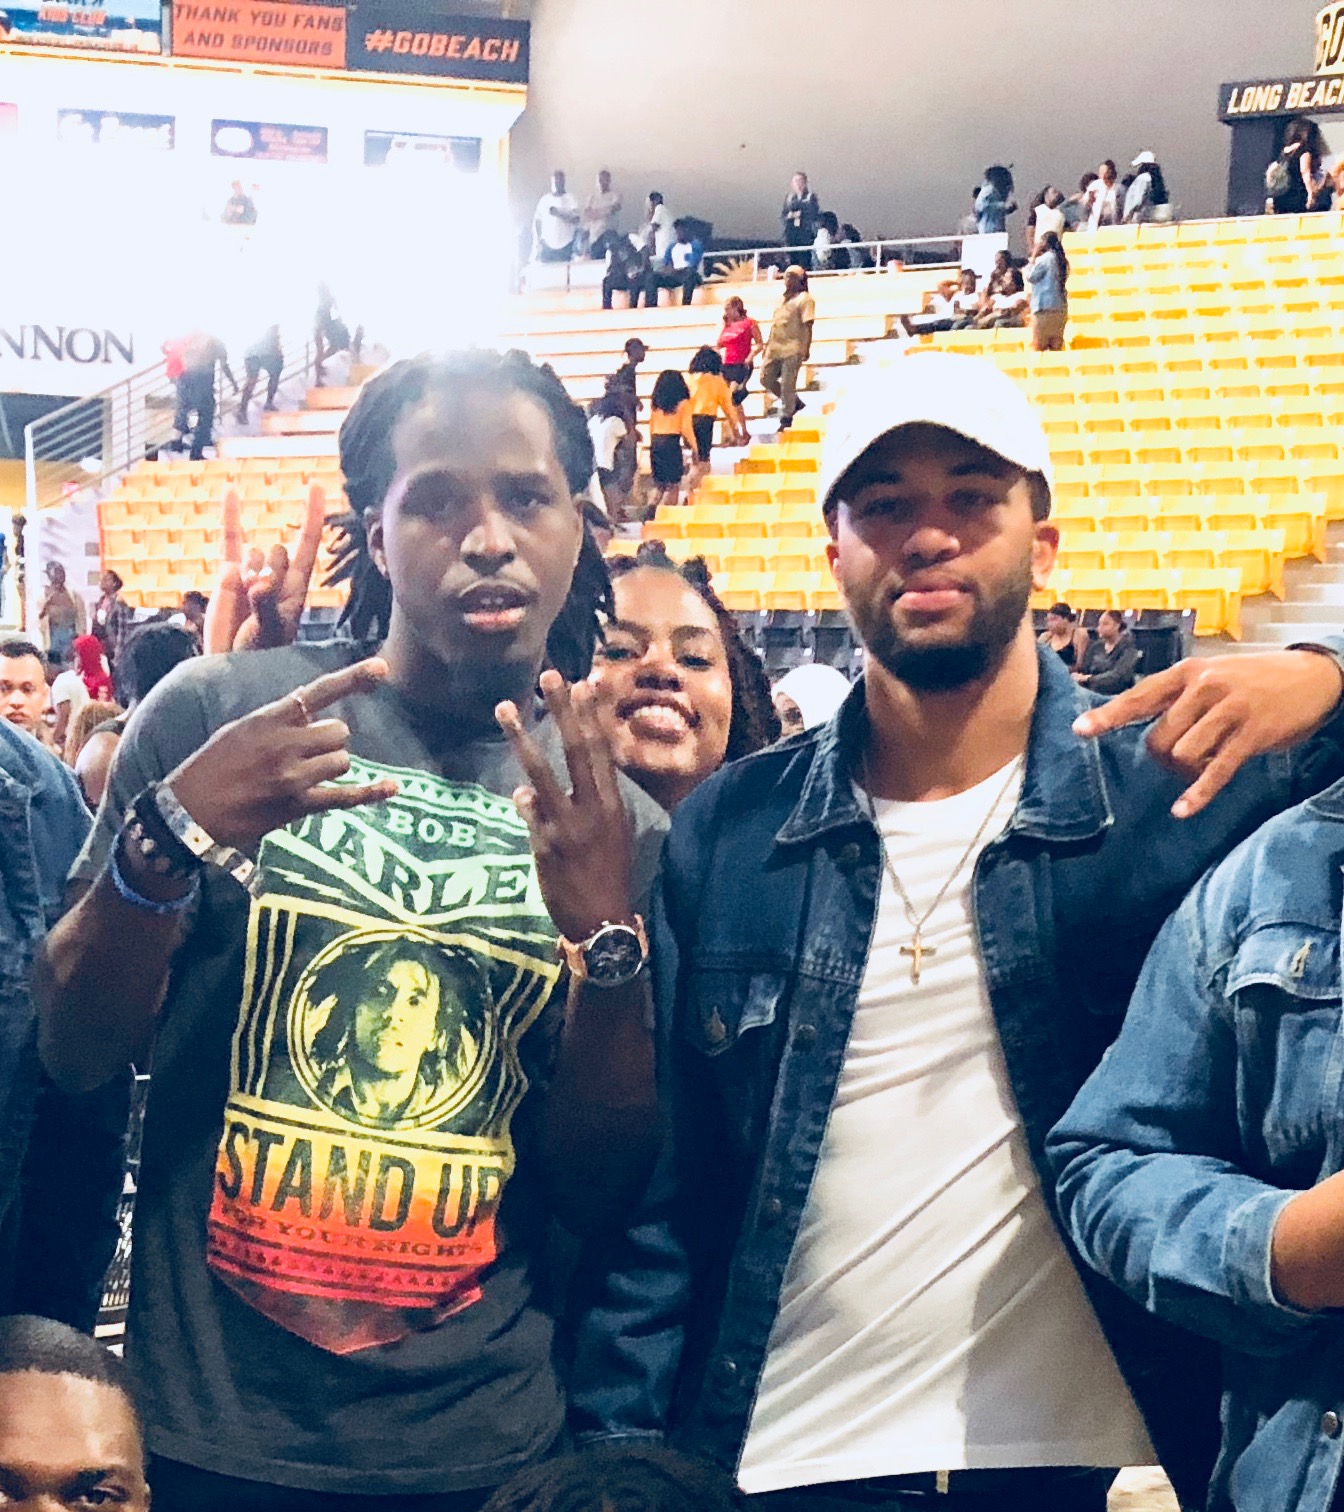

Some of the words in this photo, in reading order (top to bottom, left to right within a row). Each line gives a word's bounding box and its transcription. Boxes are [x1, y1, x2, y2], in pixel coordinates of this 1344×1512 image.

[175, 3, 240, 23] THANK
[250, 11, 287, 27] YOU
[293, 13, 344, 32] FANS
[184, 29, 224, 48] AND
[232, 34, 334, 57] SPONSORS
[365, 29, 520, 64] #GOBEACH
[1227, 86, 1284, 114] LONG
[386, 807, 477, 848] BOB
[219, 1121, 416, 1232] STAND
[432, 1162, 504, 1239] UP
